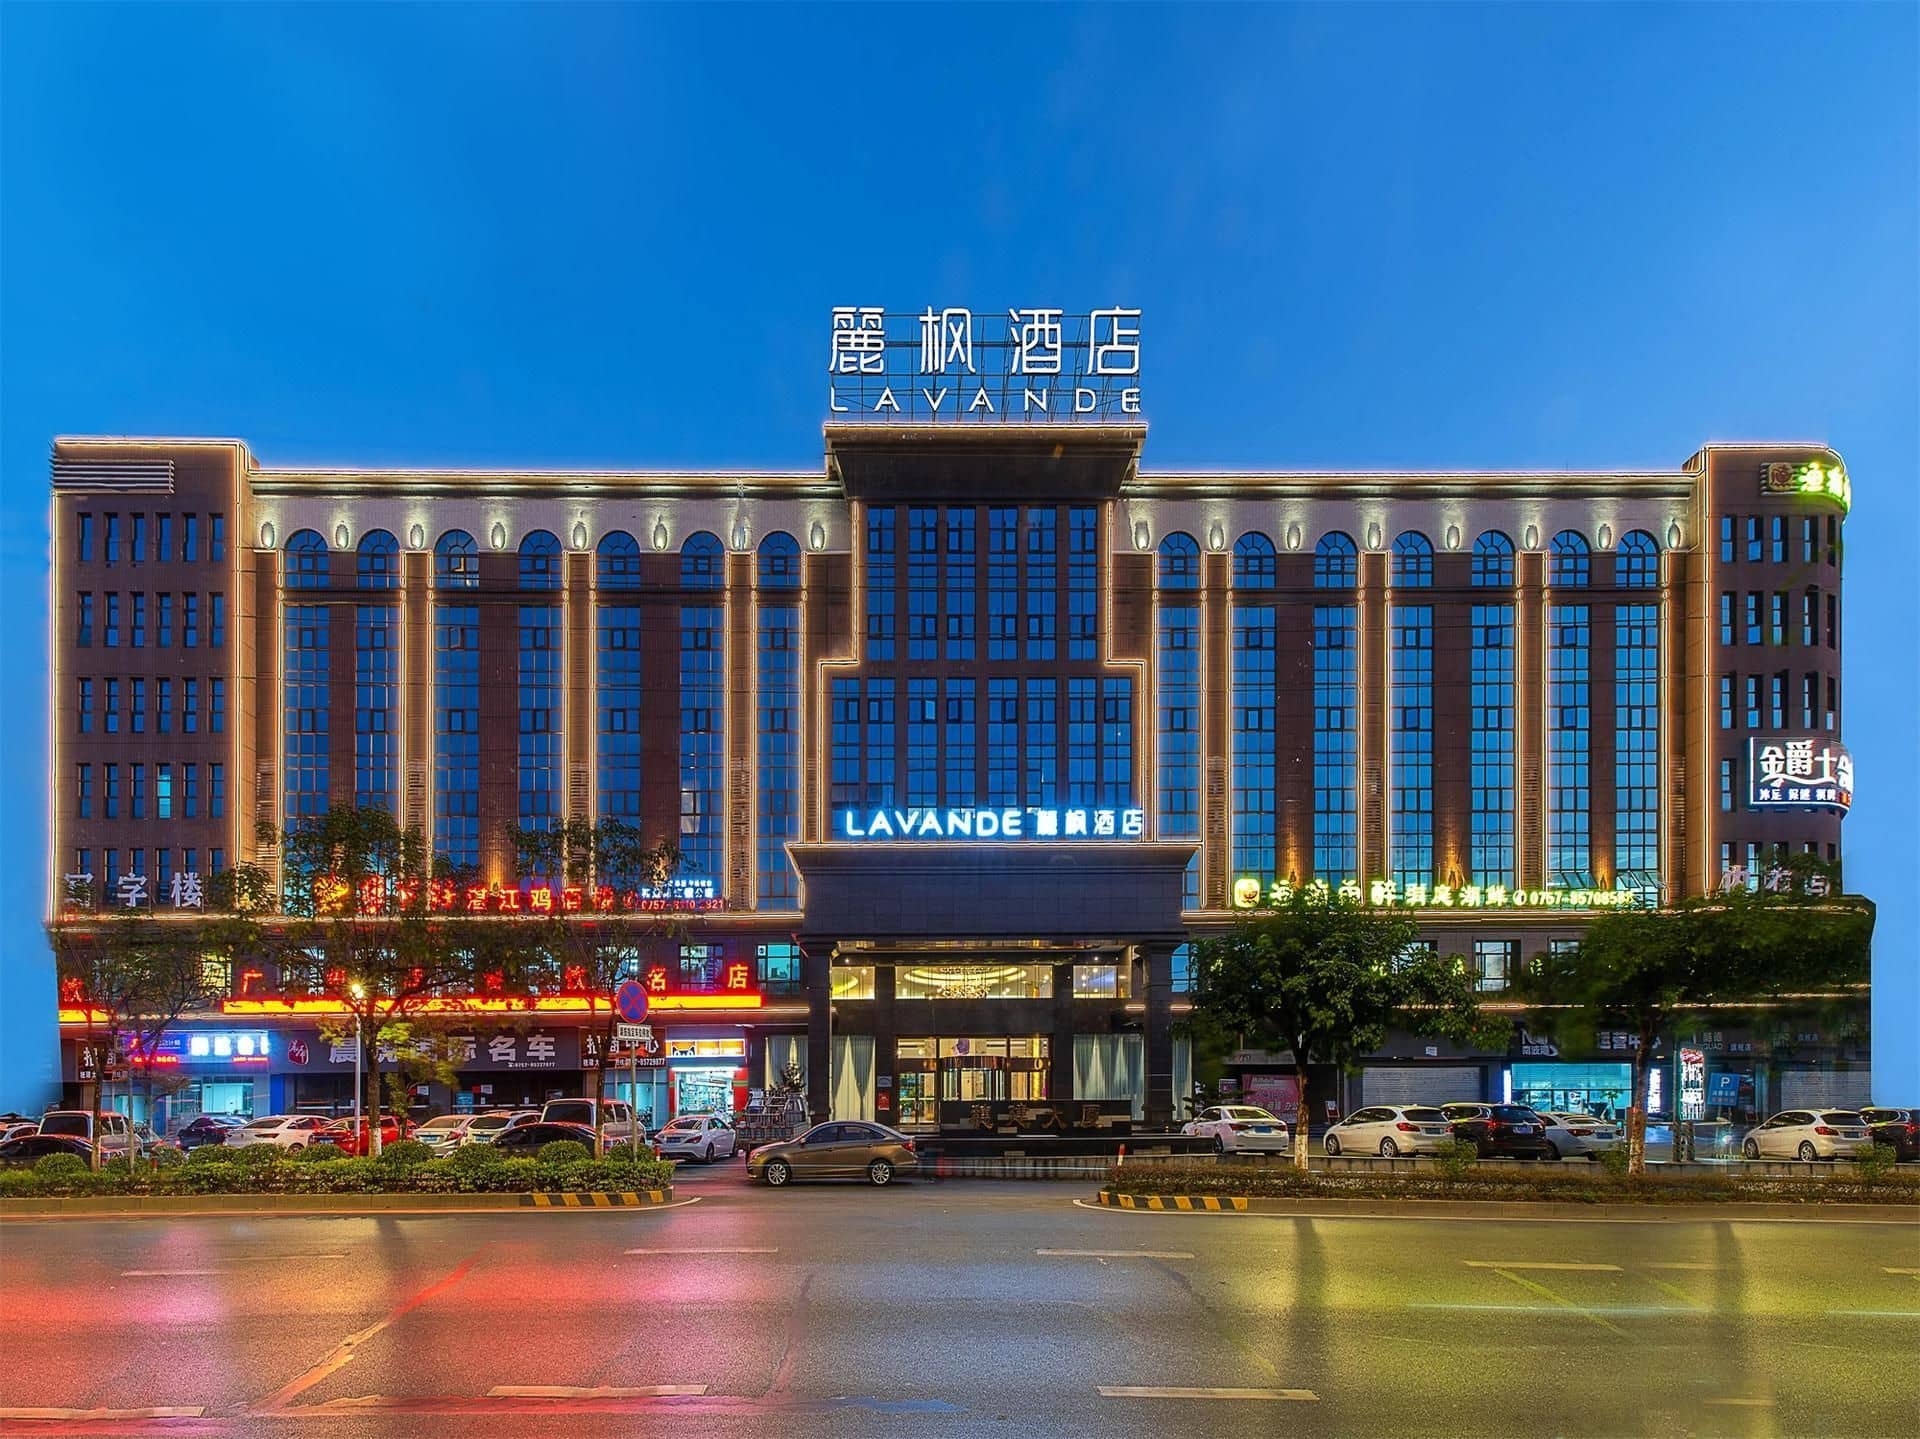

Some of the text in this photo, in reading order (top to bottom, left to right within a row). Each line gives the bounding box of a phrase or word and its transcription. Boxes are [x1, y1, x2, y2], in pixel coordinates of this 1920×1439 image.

[829, 306, 1143, 374] 麗枫酒店
[831, 387, 1142, 413] LAVANDE
[846, 810, 1022, 837] LAVANDE
